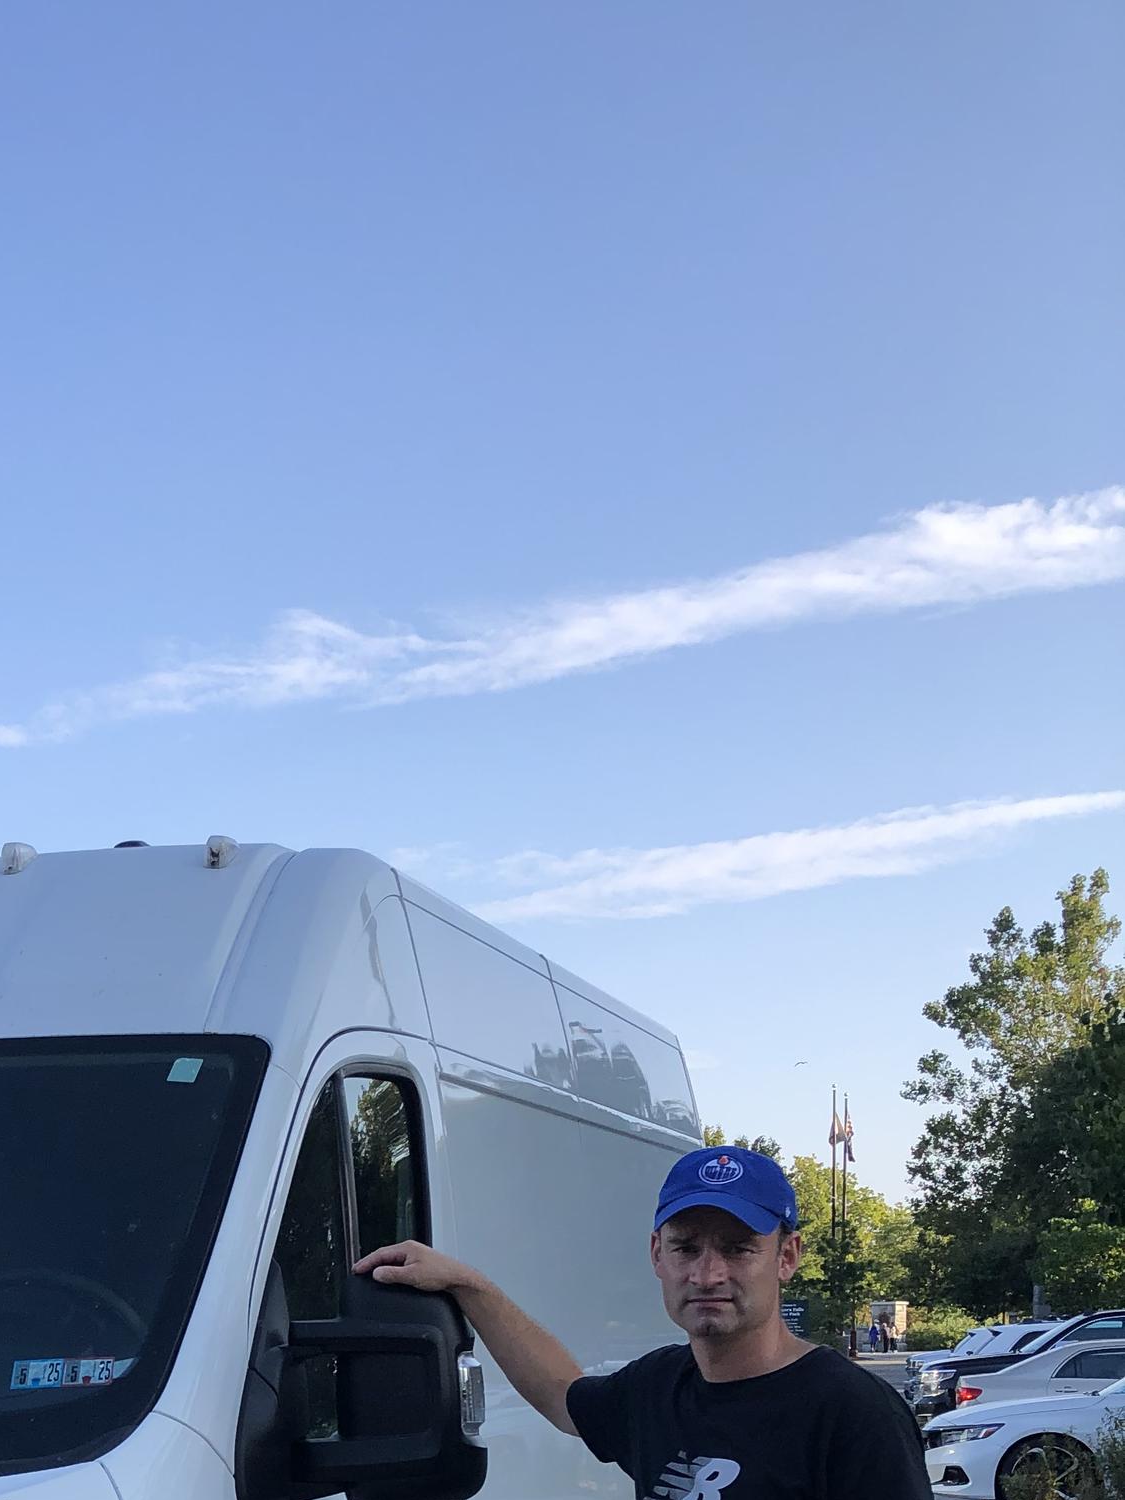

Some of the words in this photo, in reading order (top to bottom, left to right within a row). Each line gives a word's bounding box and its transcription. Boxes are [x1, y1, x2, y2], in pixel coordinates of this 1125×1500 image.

[19, 1368, 27, 1385] 5
[47, 1363, 61, 1382] 25
[70, 1366, 78, 1382] 5
[98, 1360, 112, 1381] 25
